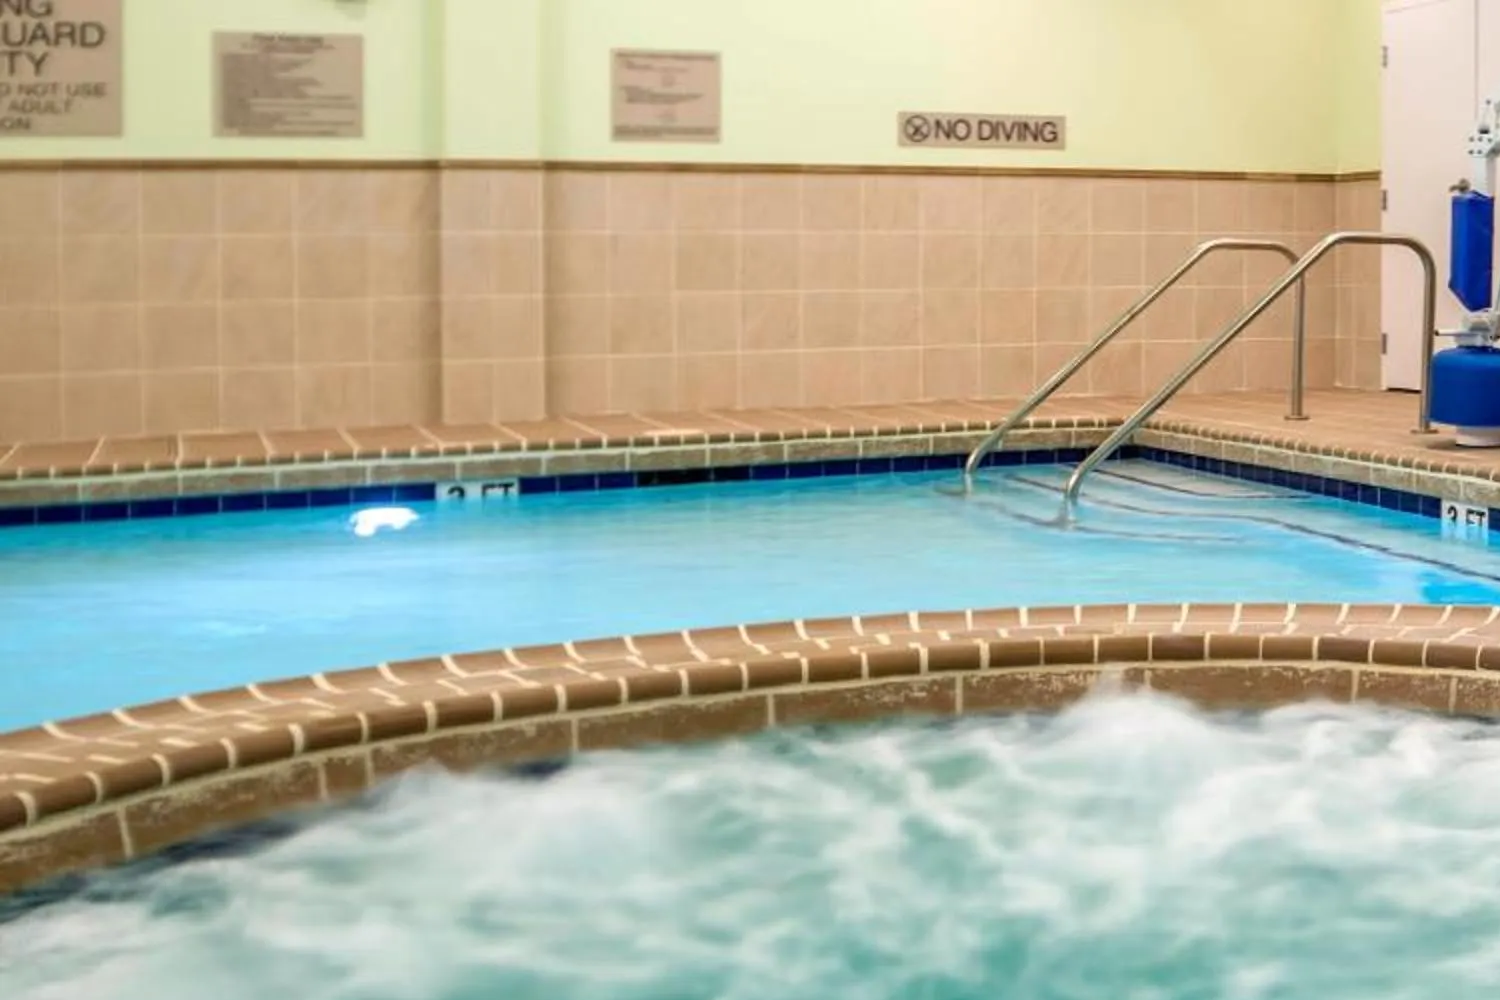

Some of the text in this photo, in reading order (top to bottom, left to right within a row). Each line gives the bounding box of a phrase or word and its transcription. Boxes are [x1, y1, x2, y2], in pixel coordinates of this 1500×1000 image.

[17, 81, 60, 98] NOT
[65, 82, 107, 98] USE
[935, 118, 1059, 143] NO DIVING
